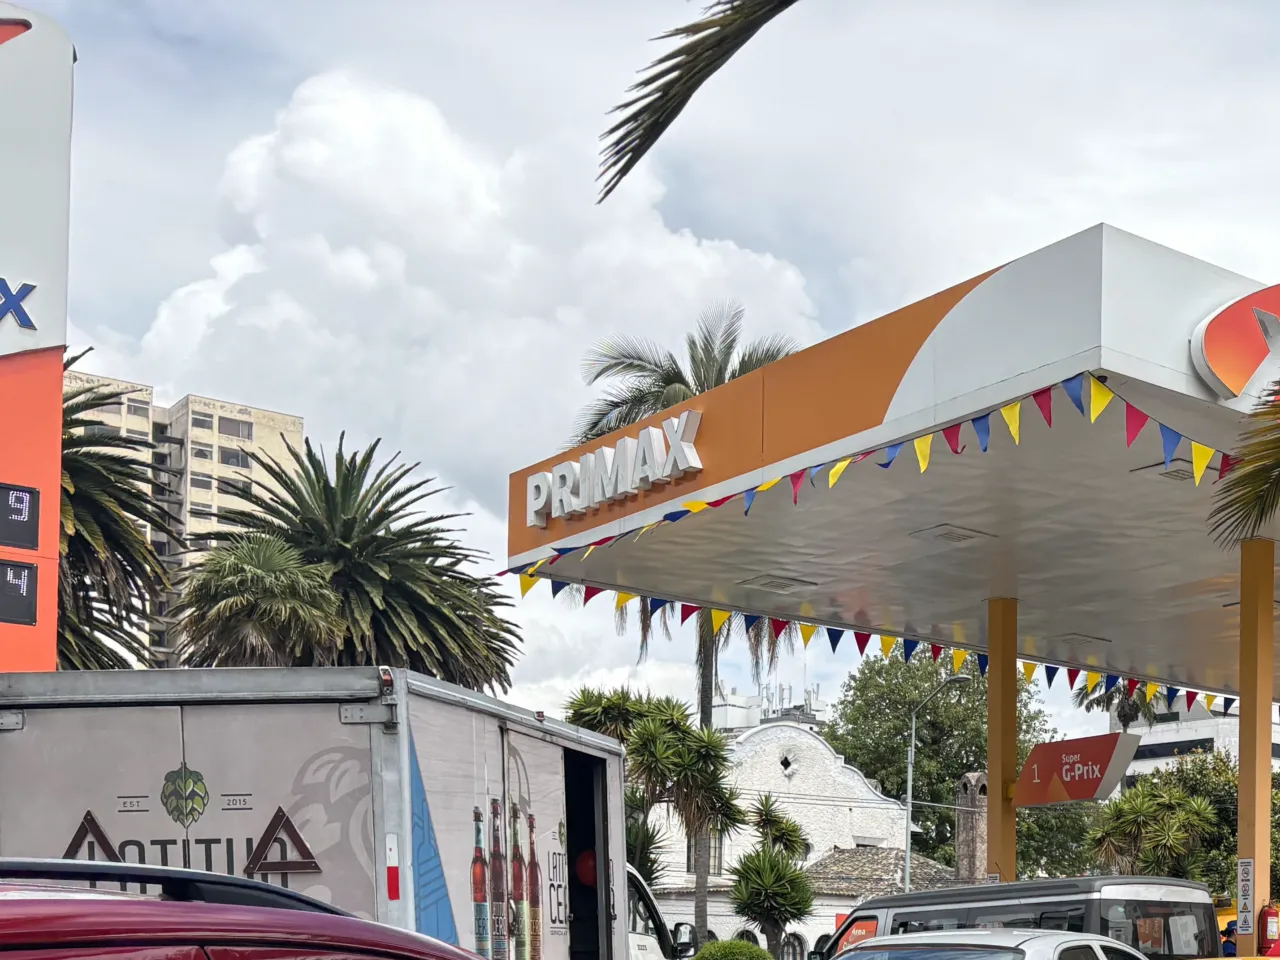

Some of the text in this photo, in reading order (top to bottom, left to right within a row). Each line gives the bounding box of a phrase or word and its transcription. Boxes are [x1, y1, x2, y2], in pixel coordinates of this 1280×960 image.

[0, 277, 37, 331] X
[527, 409, 703, 528] PRIMAX
[1061, 754, 1080, 763] Super
[1032, 763, 1041, 783] 1
[1062, 761, 1101, 782] G-Prix
[226, 798, 247, 806] 2015
